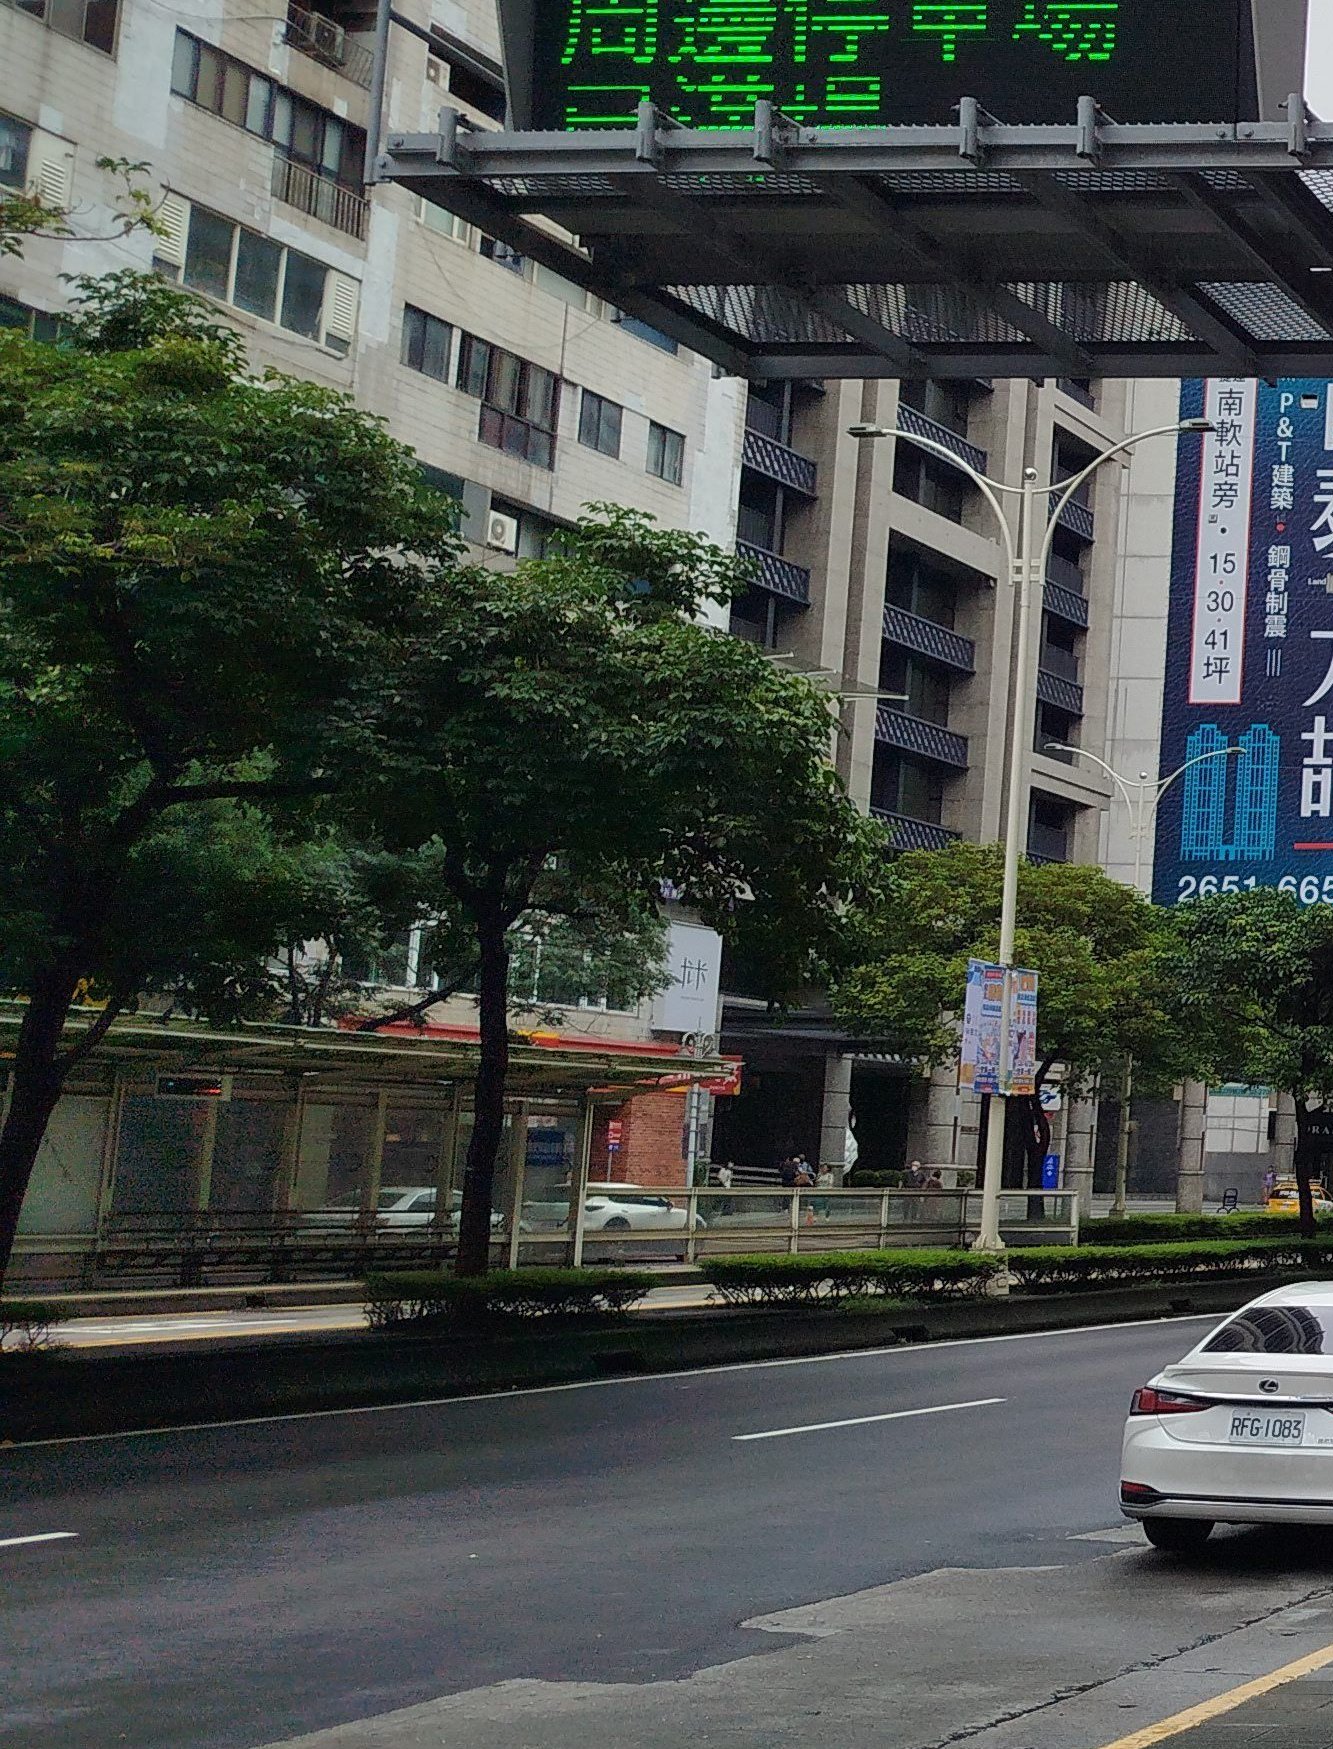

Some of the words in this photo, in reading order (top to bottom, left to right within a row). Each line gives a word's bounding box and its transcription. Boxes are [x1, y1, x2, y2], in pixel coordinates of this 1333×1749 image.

[1212, 378, 1246, 509] 南軟站旁
[1230, 1417, 1302, 1439] RFG-1083
